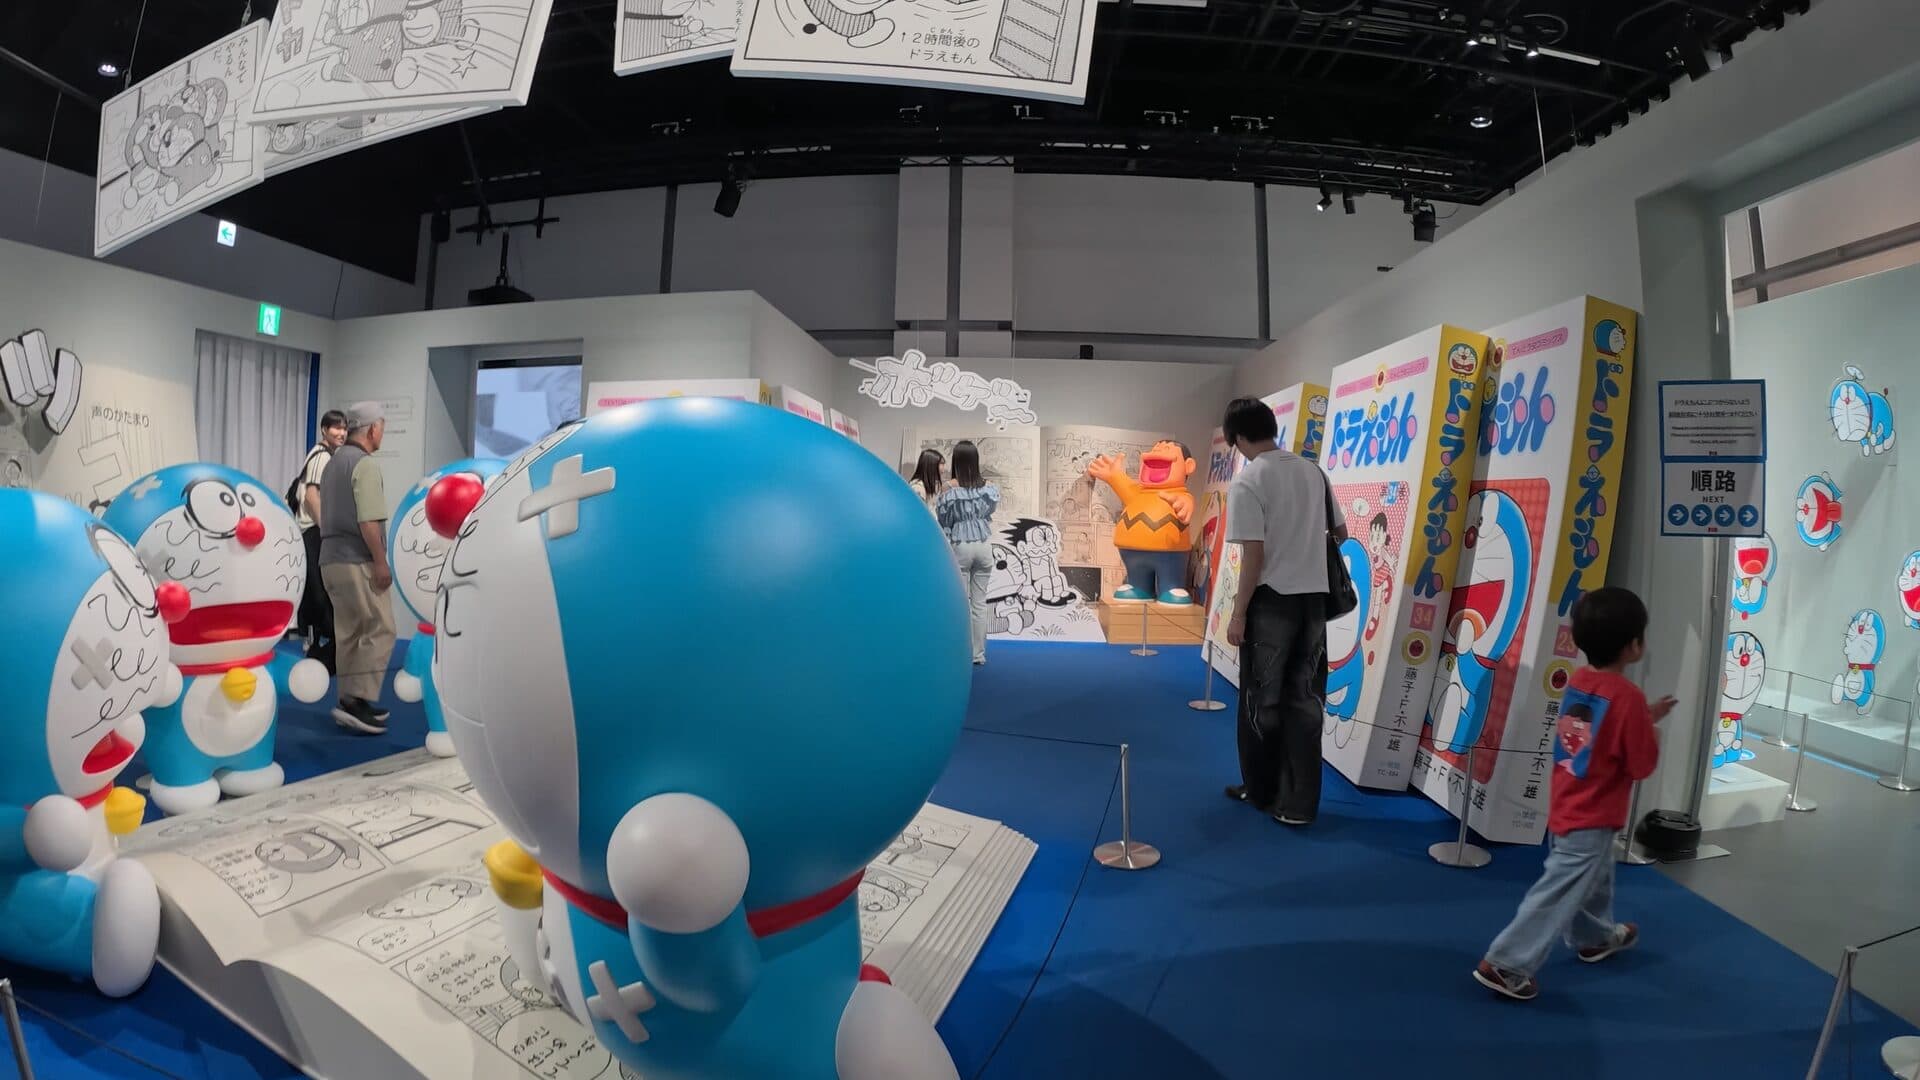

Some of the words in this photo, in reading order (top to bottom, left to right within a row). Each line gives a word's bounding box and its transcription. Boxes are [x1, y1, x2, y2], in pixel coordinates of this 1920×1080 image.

[909, 49, 977, 65] ドラえもん
[1327, 391, 1418, 471] ドラえもん
[1414, 378, 1476, 599] ドラえもん
[1690, 469, 1736, 493] 順路
[1702, 495, 1725, 504] NEXT
[1413, 608, 1432, 625] 34
